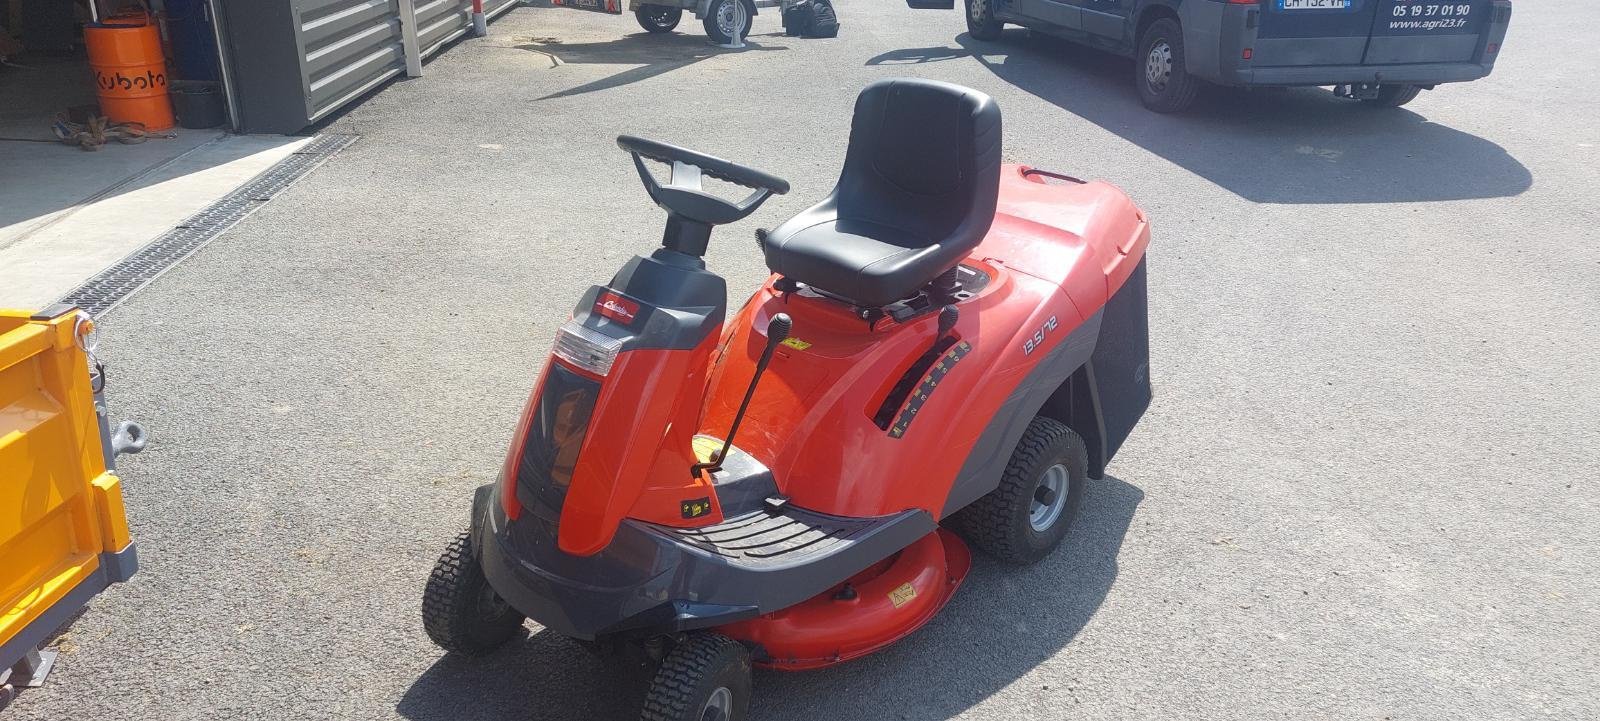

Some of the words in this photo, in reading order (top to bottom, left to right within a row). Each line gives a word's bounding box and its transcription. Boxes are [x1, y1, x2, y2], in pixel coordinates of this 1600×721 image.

[1393, 5, 1407, 16] 05
[1411, 5, 1422, 16] 19
[1425, 5, 1439, 16] 37
[1442, 5, 1454, 15] 01
[1456, 4, 1470, 15] 90
[1390, 18, 1467, 30] www.agri23.fr
[96, 70, 166, 90] Kubota
[1023, 315, 1058, 356] 13.5/72
